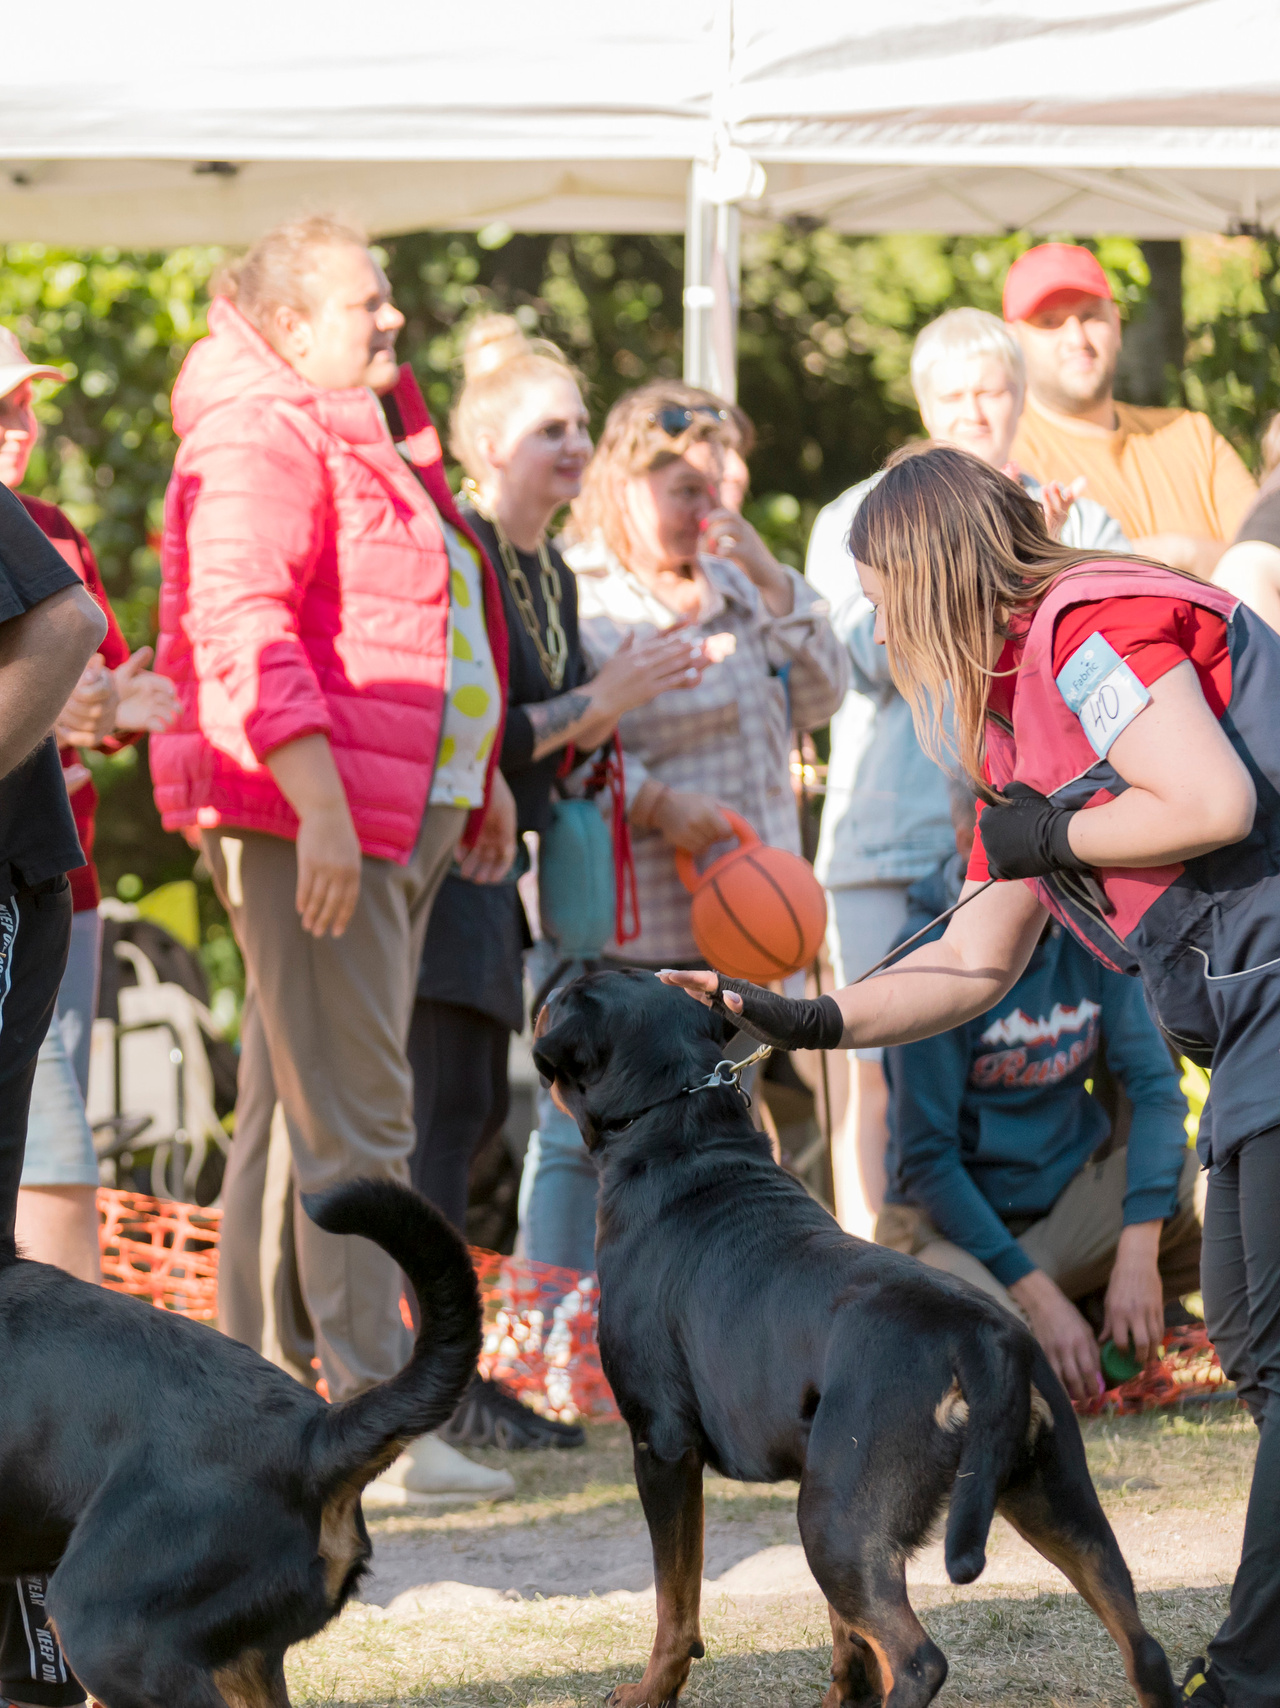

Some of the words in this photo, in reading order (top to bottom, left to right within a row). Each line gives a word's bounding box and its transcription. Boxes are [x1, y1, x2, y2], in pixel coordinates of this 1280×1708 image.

[1089, 684, 1120, 734] 40
[35, 1628, 55, 1666] KEEP
[41, 1665, 58, 1684] ON
